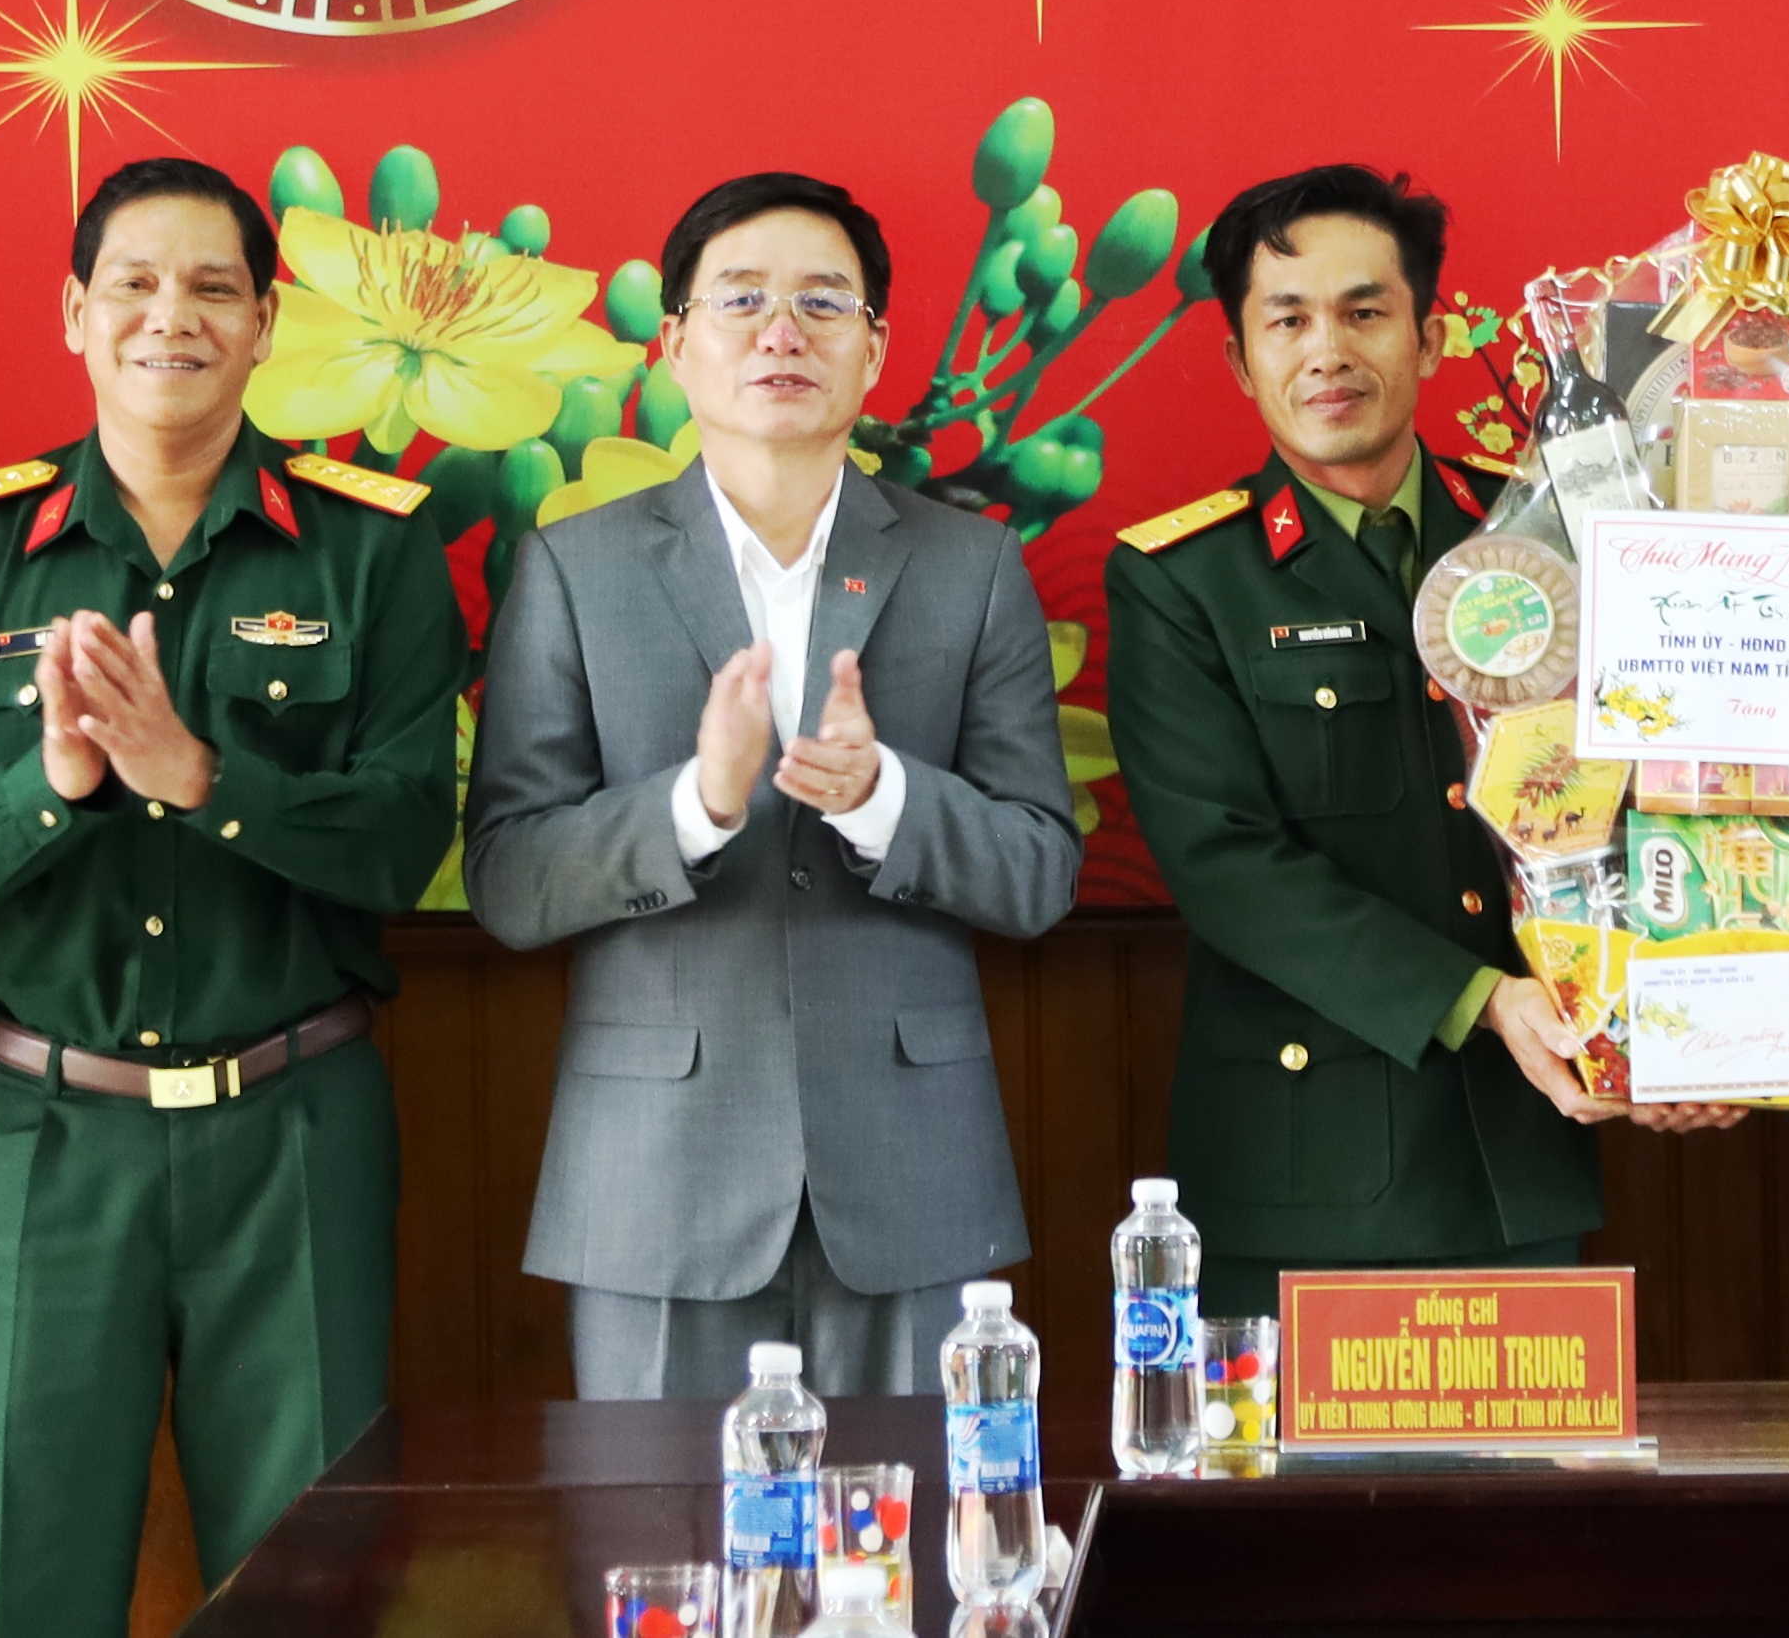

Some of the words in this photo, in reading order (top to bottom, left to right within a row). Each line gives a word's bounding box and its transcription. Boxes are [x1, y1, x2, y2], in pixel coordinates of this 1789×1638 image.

[1609, 537, 1689, 574] Chúc
[1659, 629, 1696, 649] TỈNH
[1740, 637, 1786, 653] HĐND
[1618, 659, 1685, 675] UBMTTQ
[1691, 657, 1725, 678] VIỆT
[1731, 661, 1769, 677] NAM
[1653, 848, 1674, 914] MILO
[1416, 1290, 1464, 1326] ĐỒNG
[1469, 1292, 1499, 1325] CHÍ
[1331, 1317, 1431, 1391] NGUYỄN
[1437, 1326, 1497, 1390] ĐÌNH
[1504, 1336, 1586, 1389] TRUNG
[1318, 1396, 1347, 1430] VIÊN
[1349, 1400, 1391, 1429] TRUNG
[1474, 1395, 1488, 1428] BÍ
[1517, 1390, 1545, 1427] TỈNH
